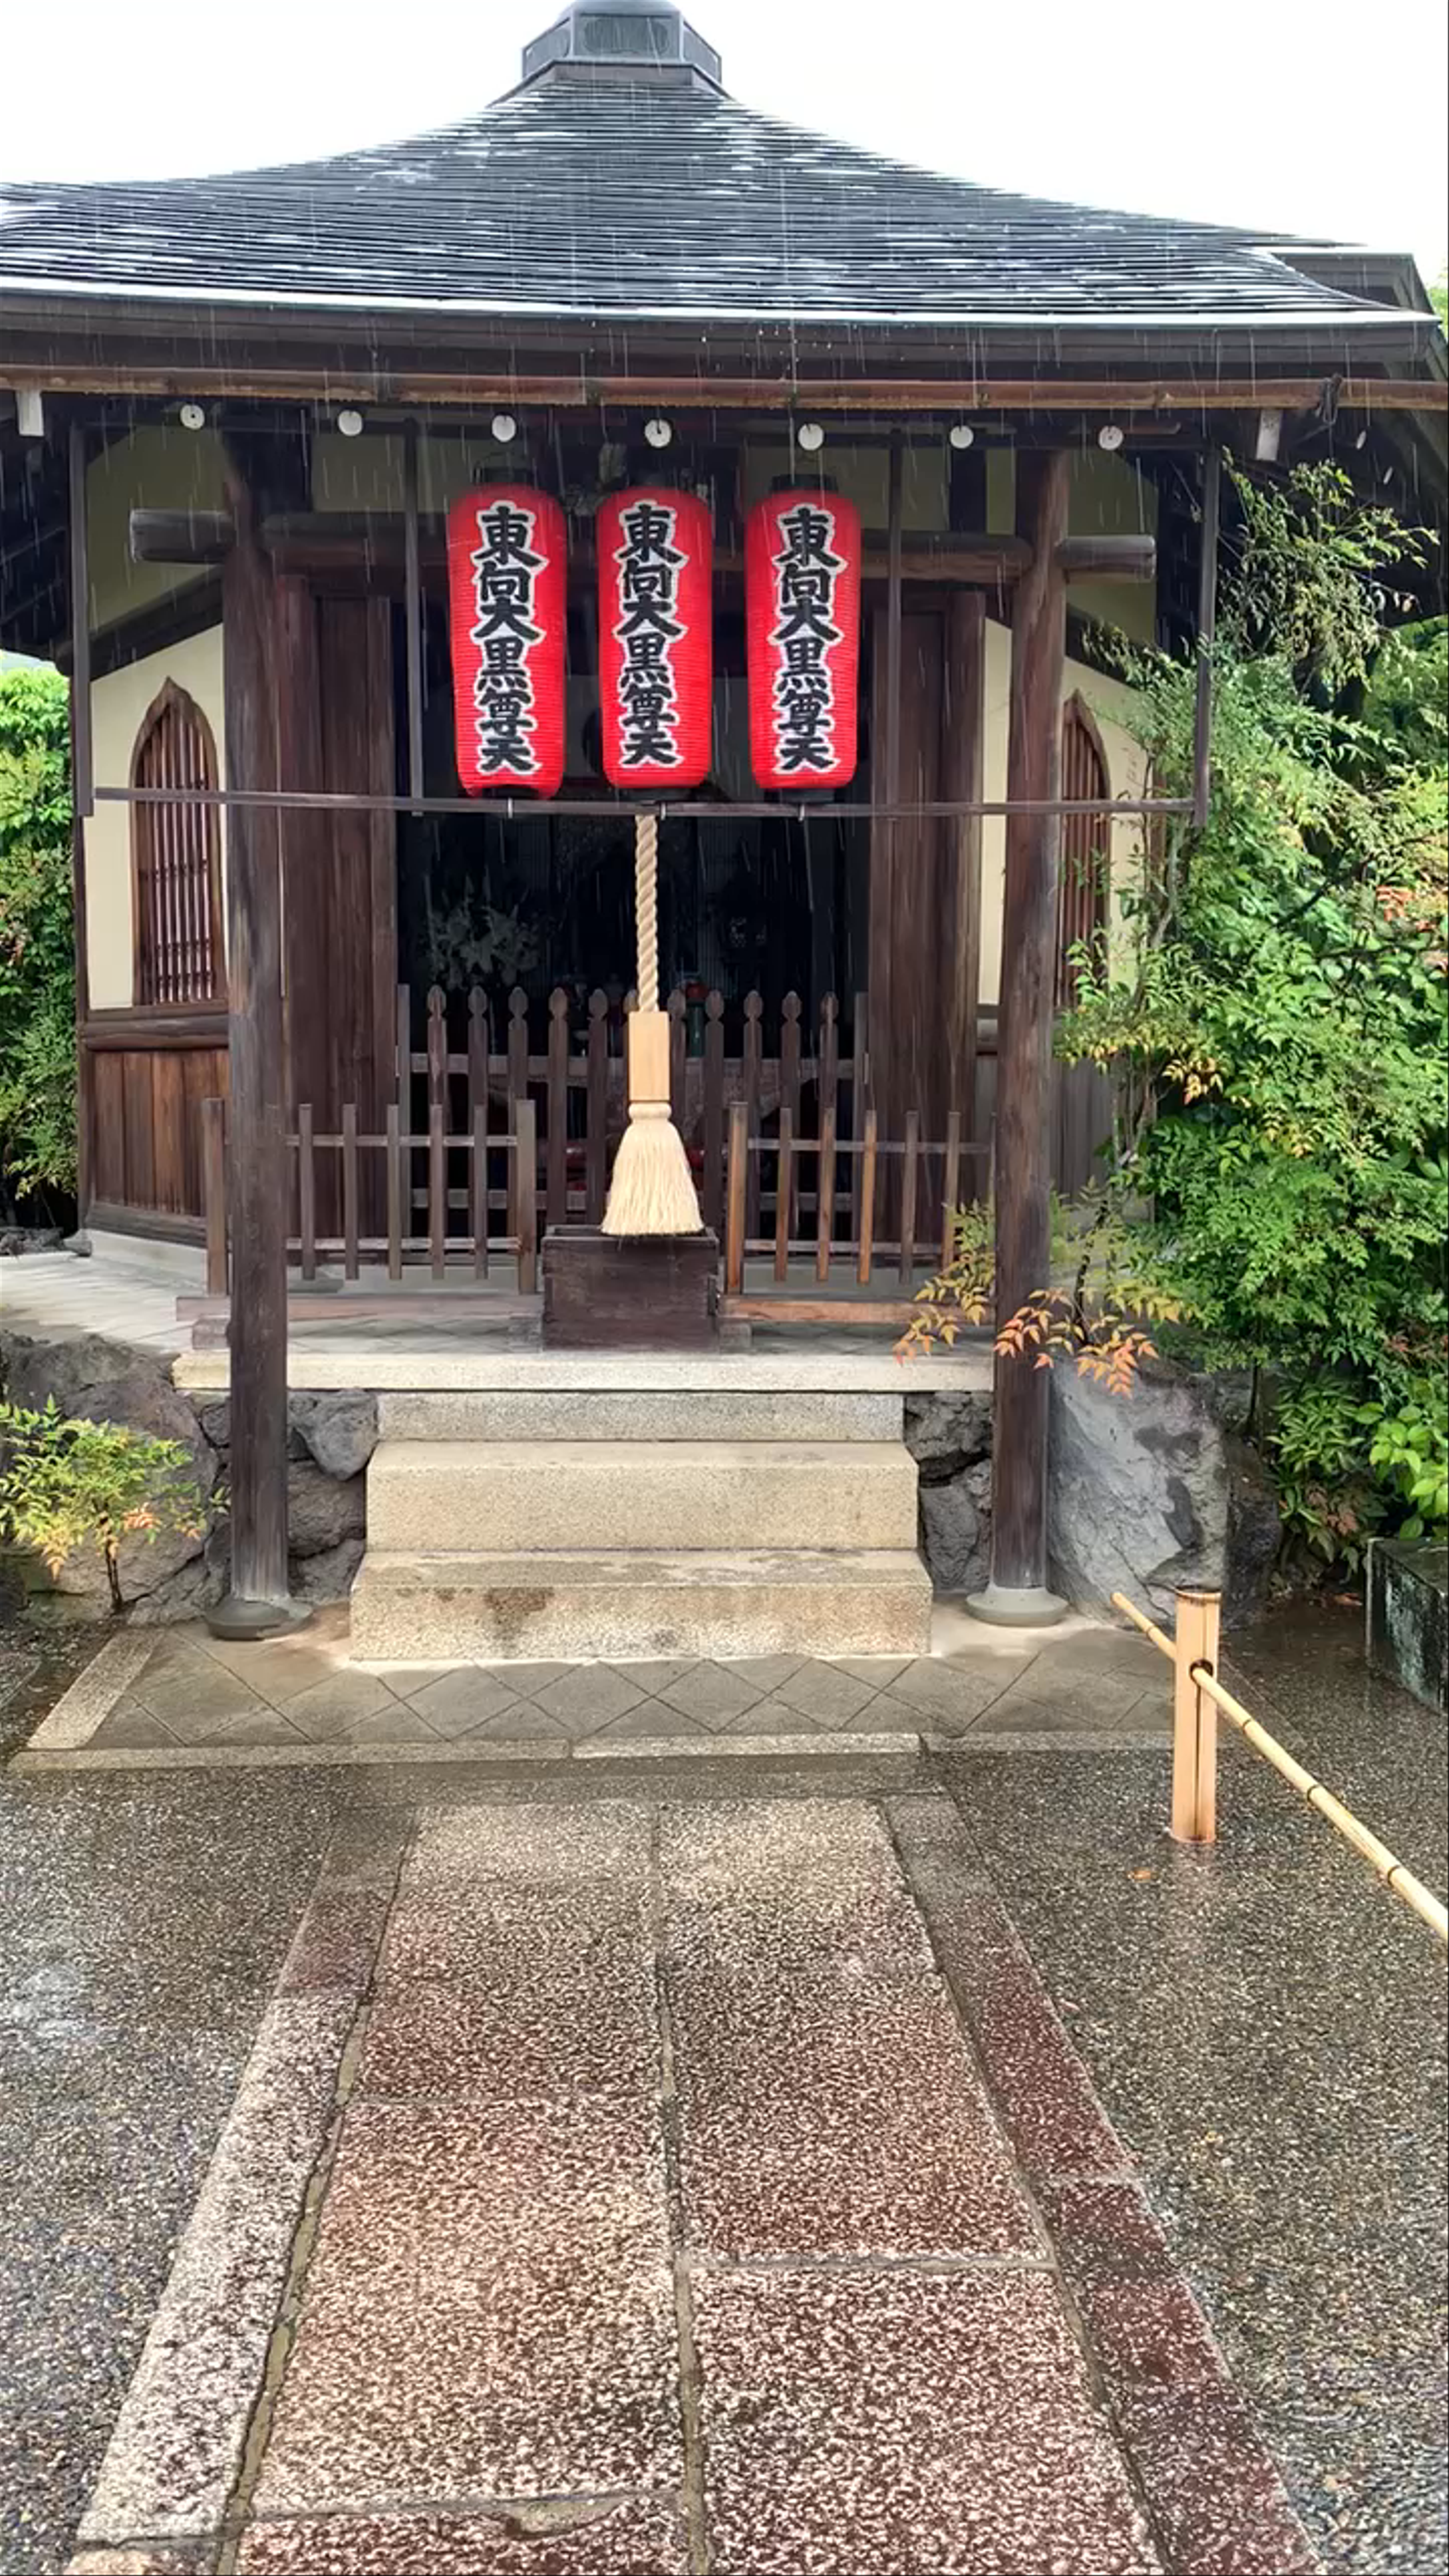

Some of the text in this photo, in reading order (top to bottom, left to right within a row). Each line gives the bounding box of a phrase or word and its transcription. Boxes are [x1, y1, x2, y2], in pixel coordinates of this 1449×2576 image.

[472, 504, 543, 772] 東向大黒尊天
[615, 502, 685, 766] 東向大黒尊天
[773, 505, 842, 772] 東向大黒尊天
